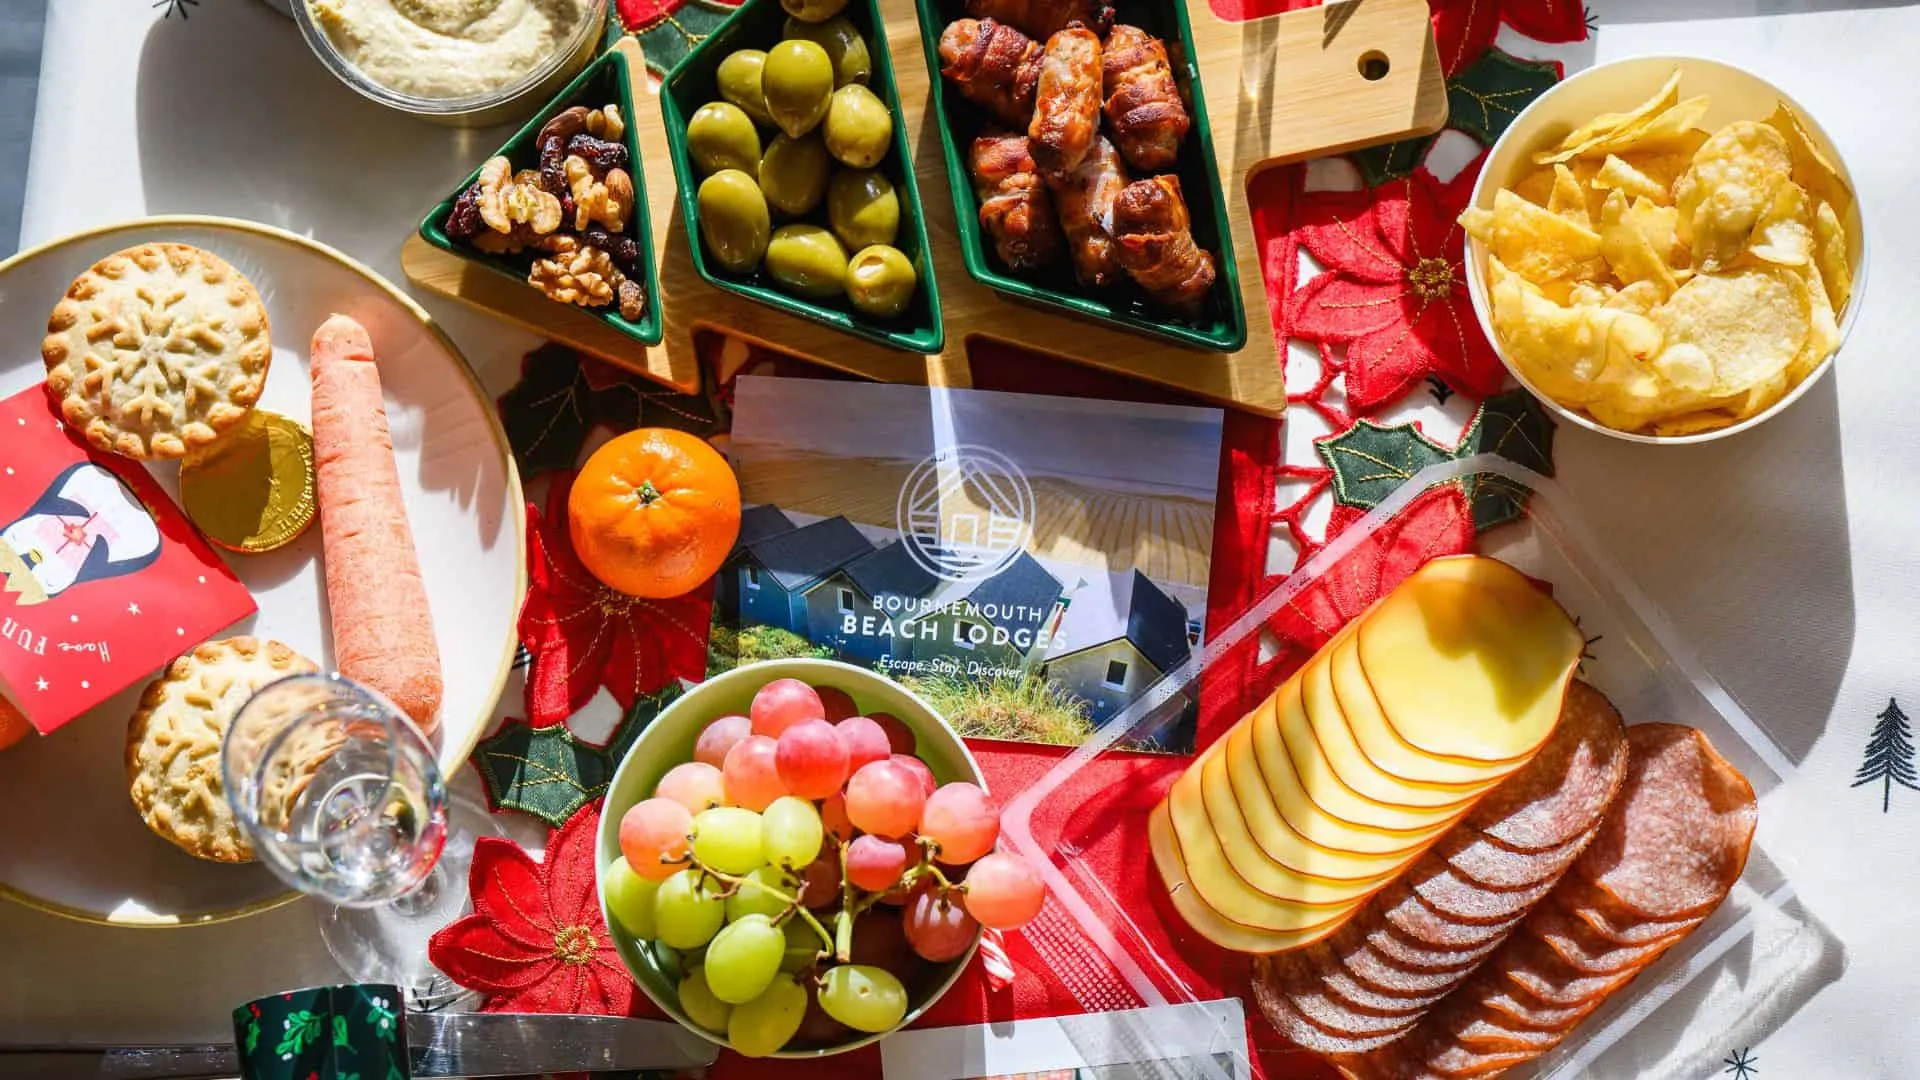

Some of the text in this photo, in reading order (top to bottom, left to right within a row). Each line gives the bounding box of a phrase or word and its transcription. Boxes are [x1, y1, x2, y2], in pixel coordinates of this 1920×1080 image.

[873, 595, 1042, 622] BOURNEMOUTH
[843, 615, 1067, 649] BEACH LODGES
[57, 641, 111, 663] Have
[879, 654, 1023, 678] Escape. Stay. Discover.
